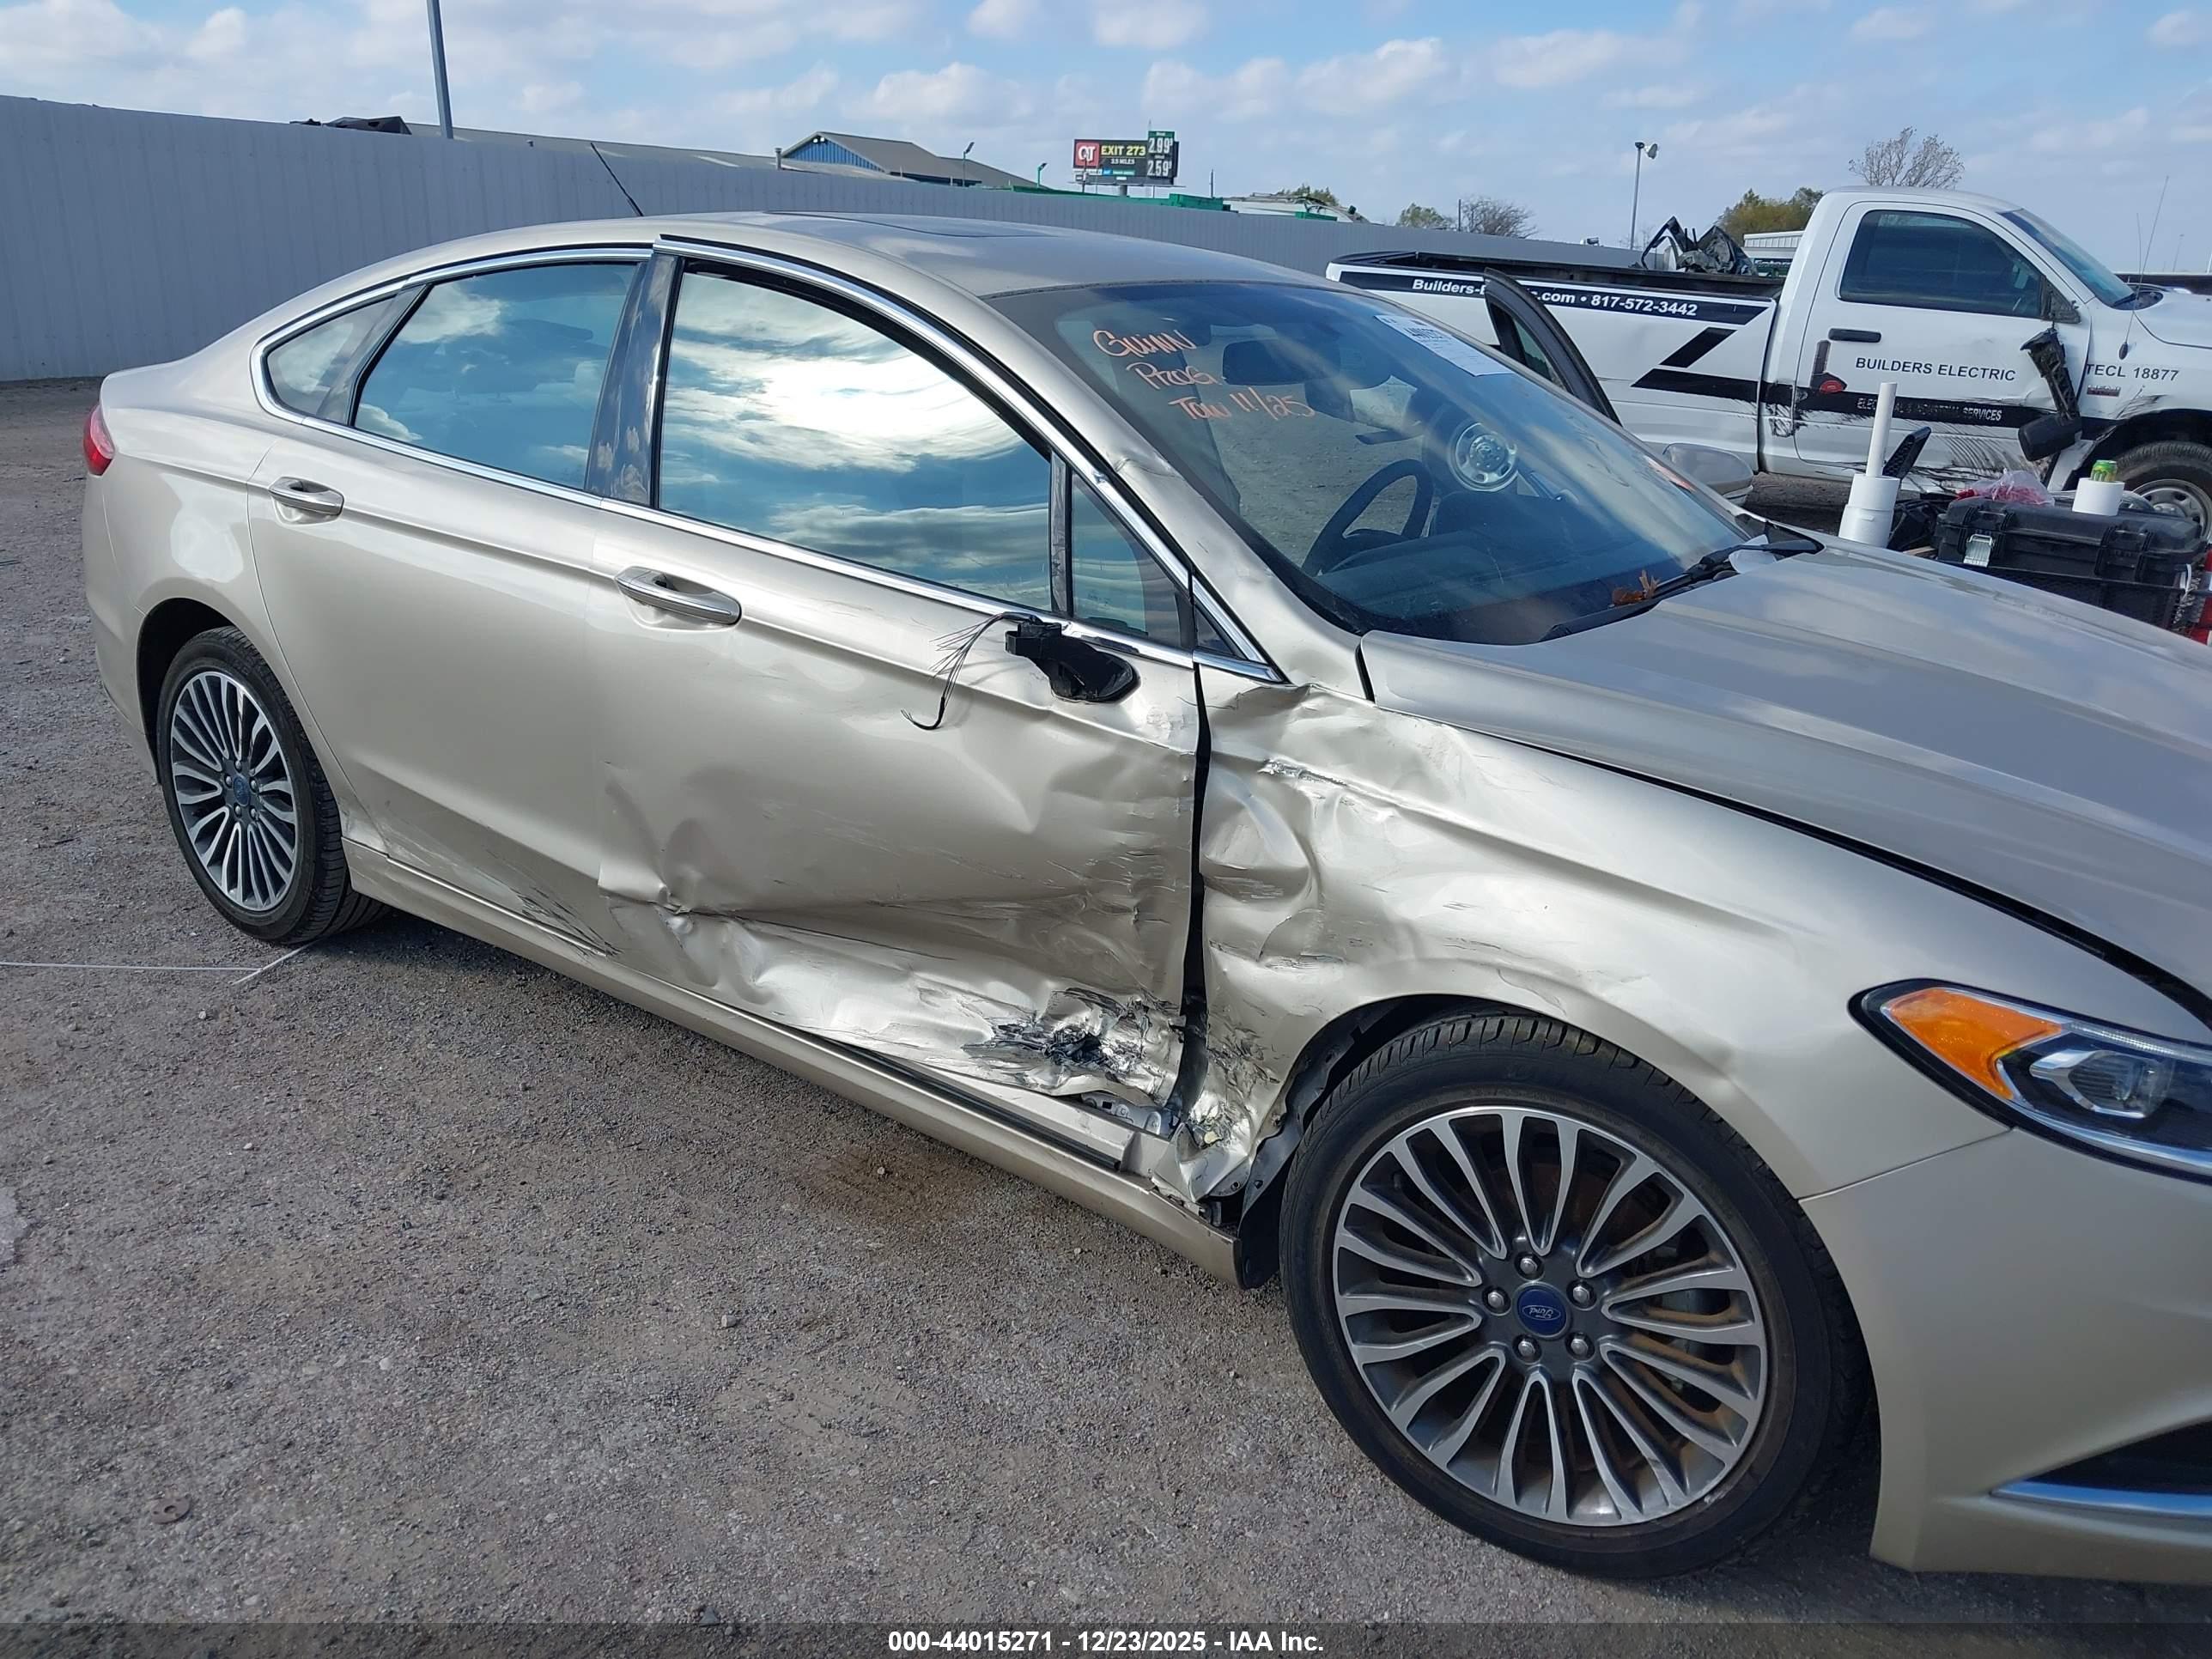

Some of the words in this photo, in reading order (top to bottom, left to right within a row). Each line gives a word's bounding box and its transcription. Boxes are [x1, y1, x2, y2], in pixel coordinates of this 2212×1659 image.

[1100, 144, 1125, 155] EXIT
[1126, 145, 1146, 156] 273
[1590, 295, 1698, 316] 817-572-3442
[1855, 356, 1933, 374] BUILDERS
[1937, 364, 2016, 382] ELECTRIC
[2087, 363, 2126, 378] TECL
[2133, 367, 2179, 381] 18877
[1529, 1307, 1553, 1319] Ford
